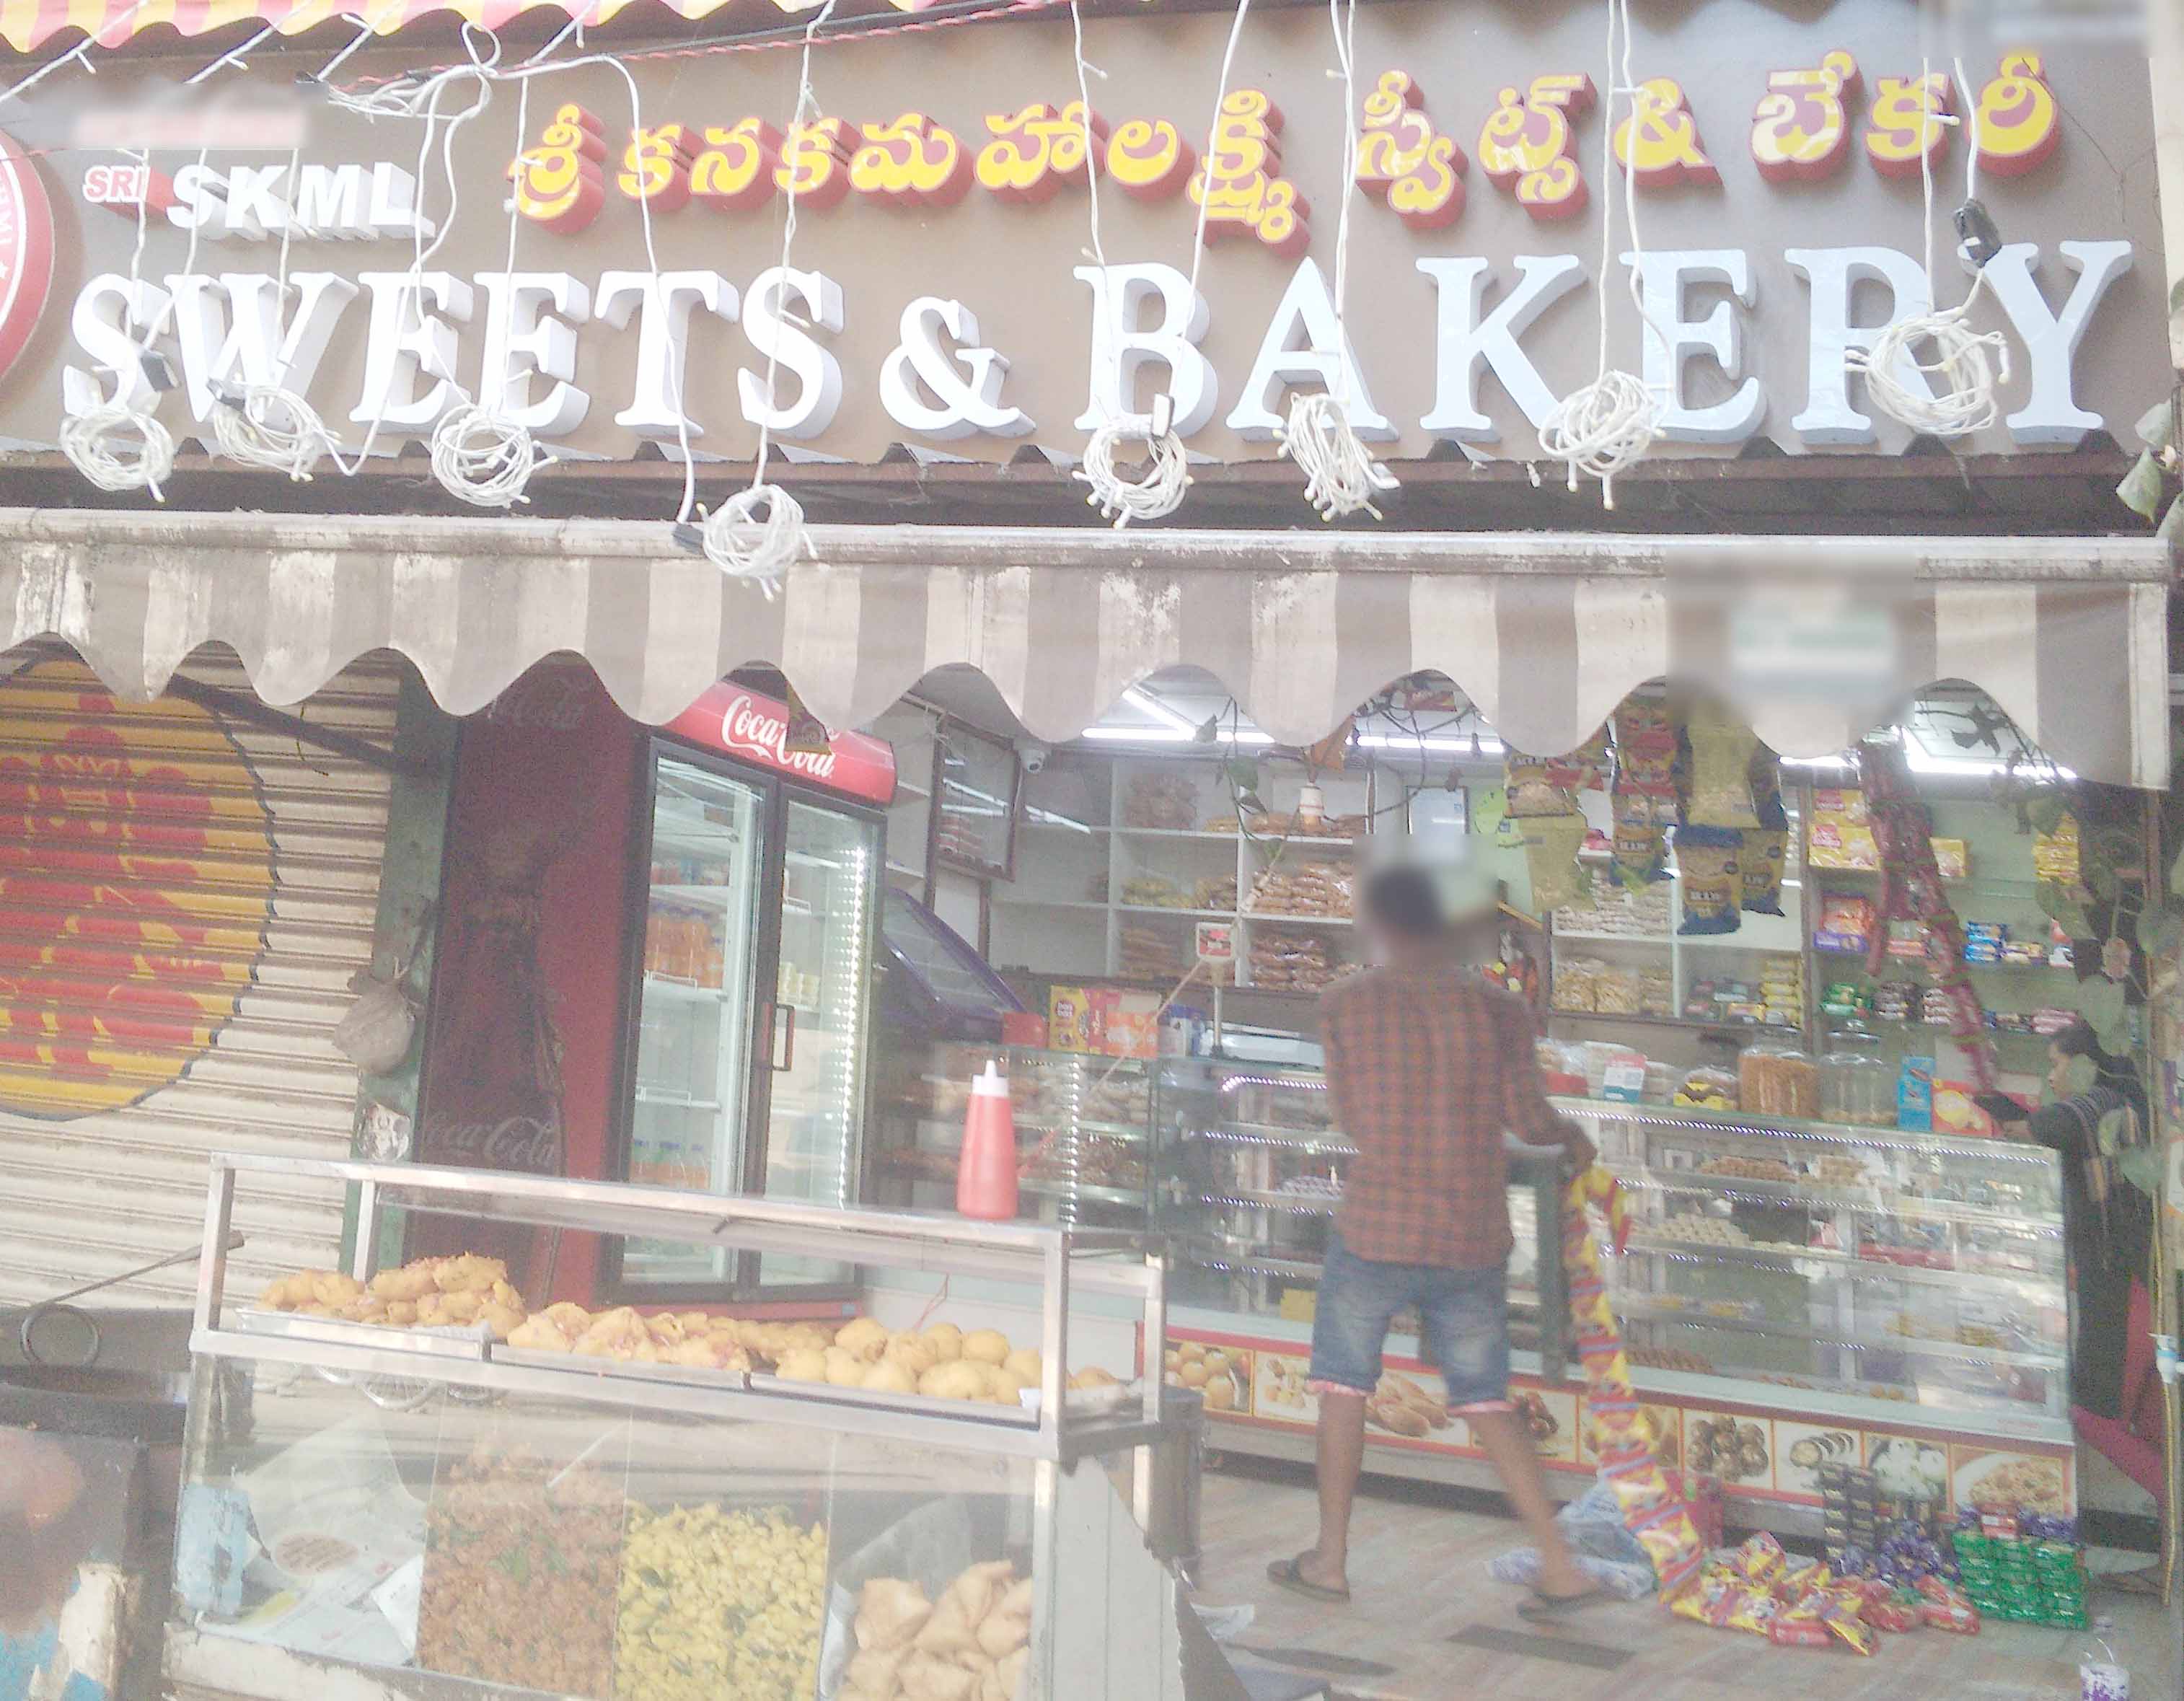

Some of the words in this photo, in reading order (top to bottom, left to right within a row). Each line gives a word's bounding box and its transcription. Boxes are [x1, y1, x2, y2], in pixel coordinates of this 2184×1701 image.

[83, 164, 151, 203] SRI
[167, 162, 422, 232] SKML
[507, 102, 590, 222] శ్రీ
[1613, 78, 1715, 173] &
[63, 266, 829, 433] SWEETS
[879, 296, 1028, 433] &
[1073, 239, 2133, 435] BAKERY
